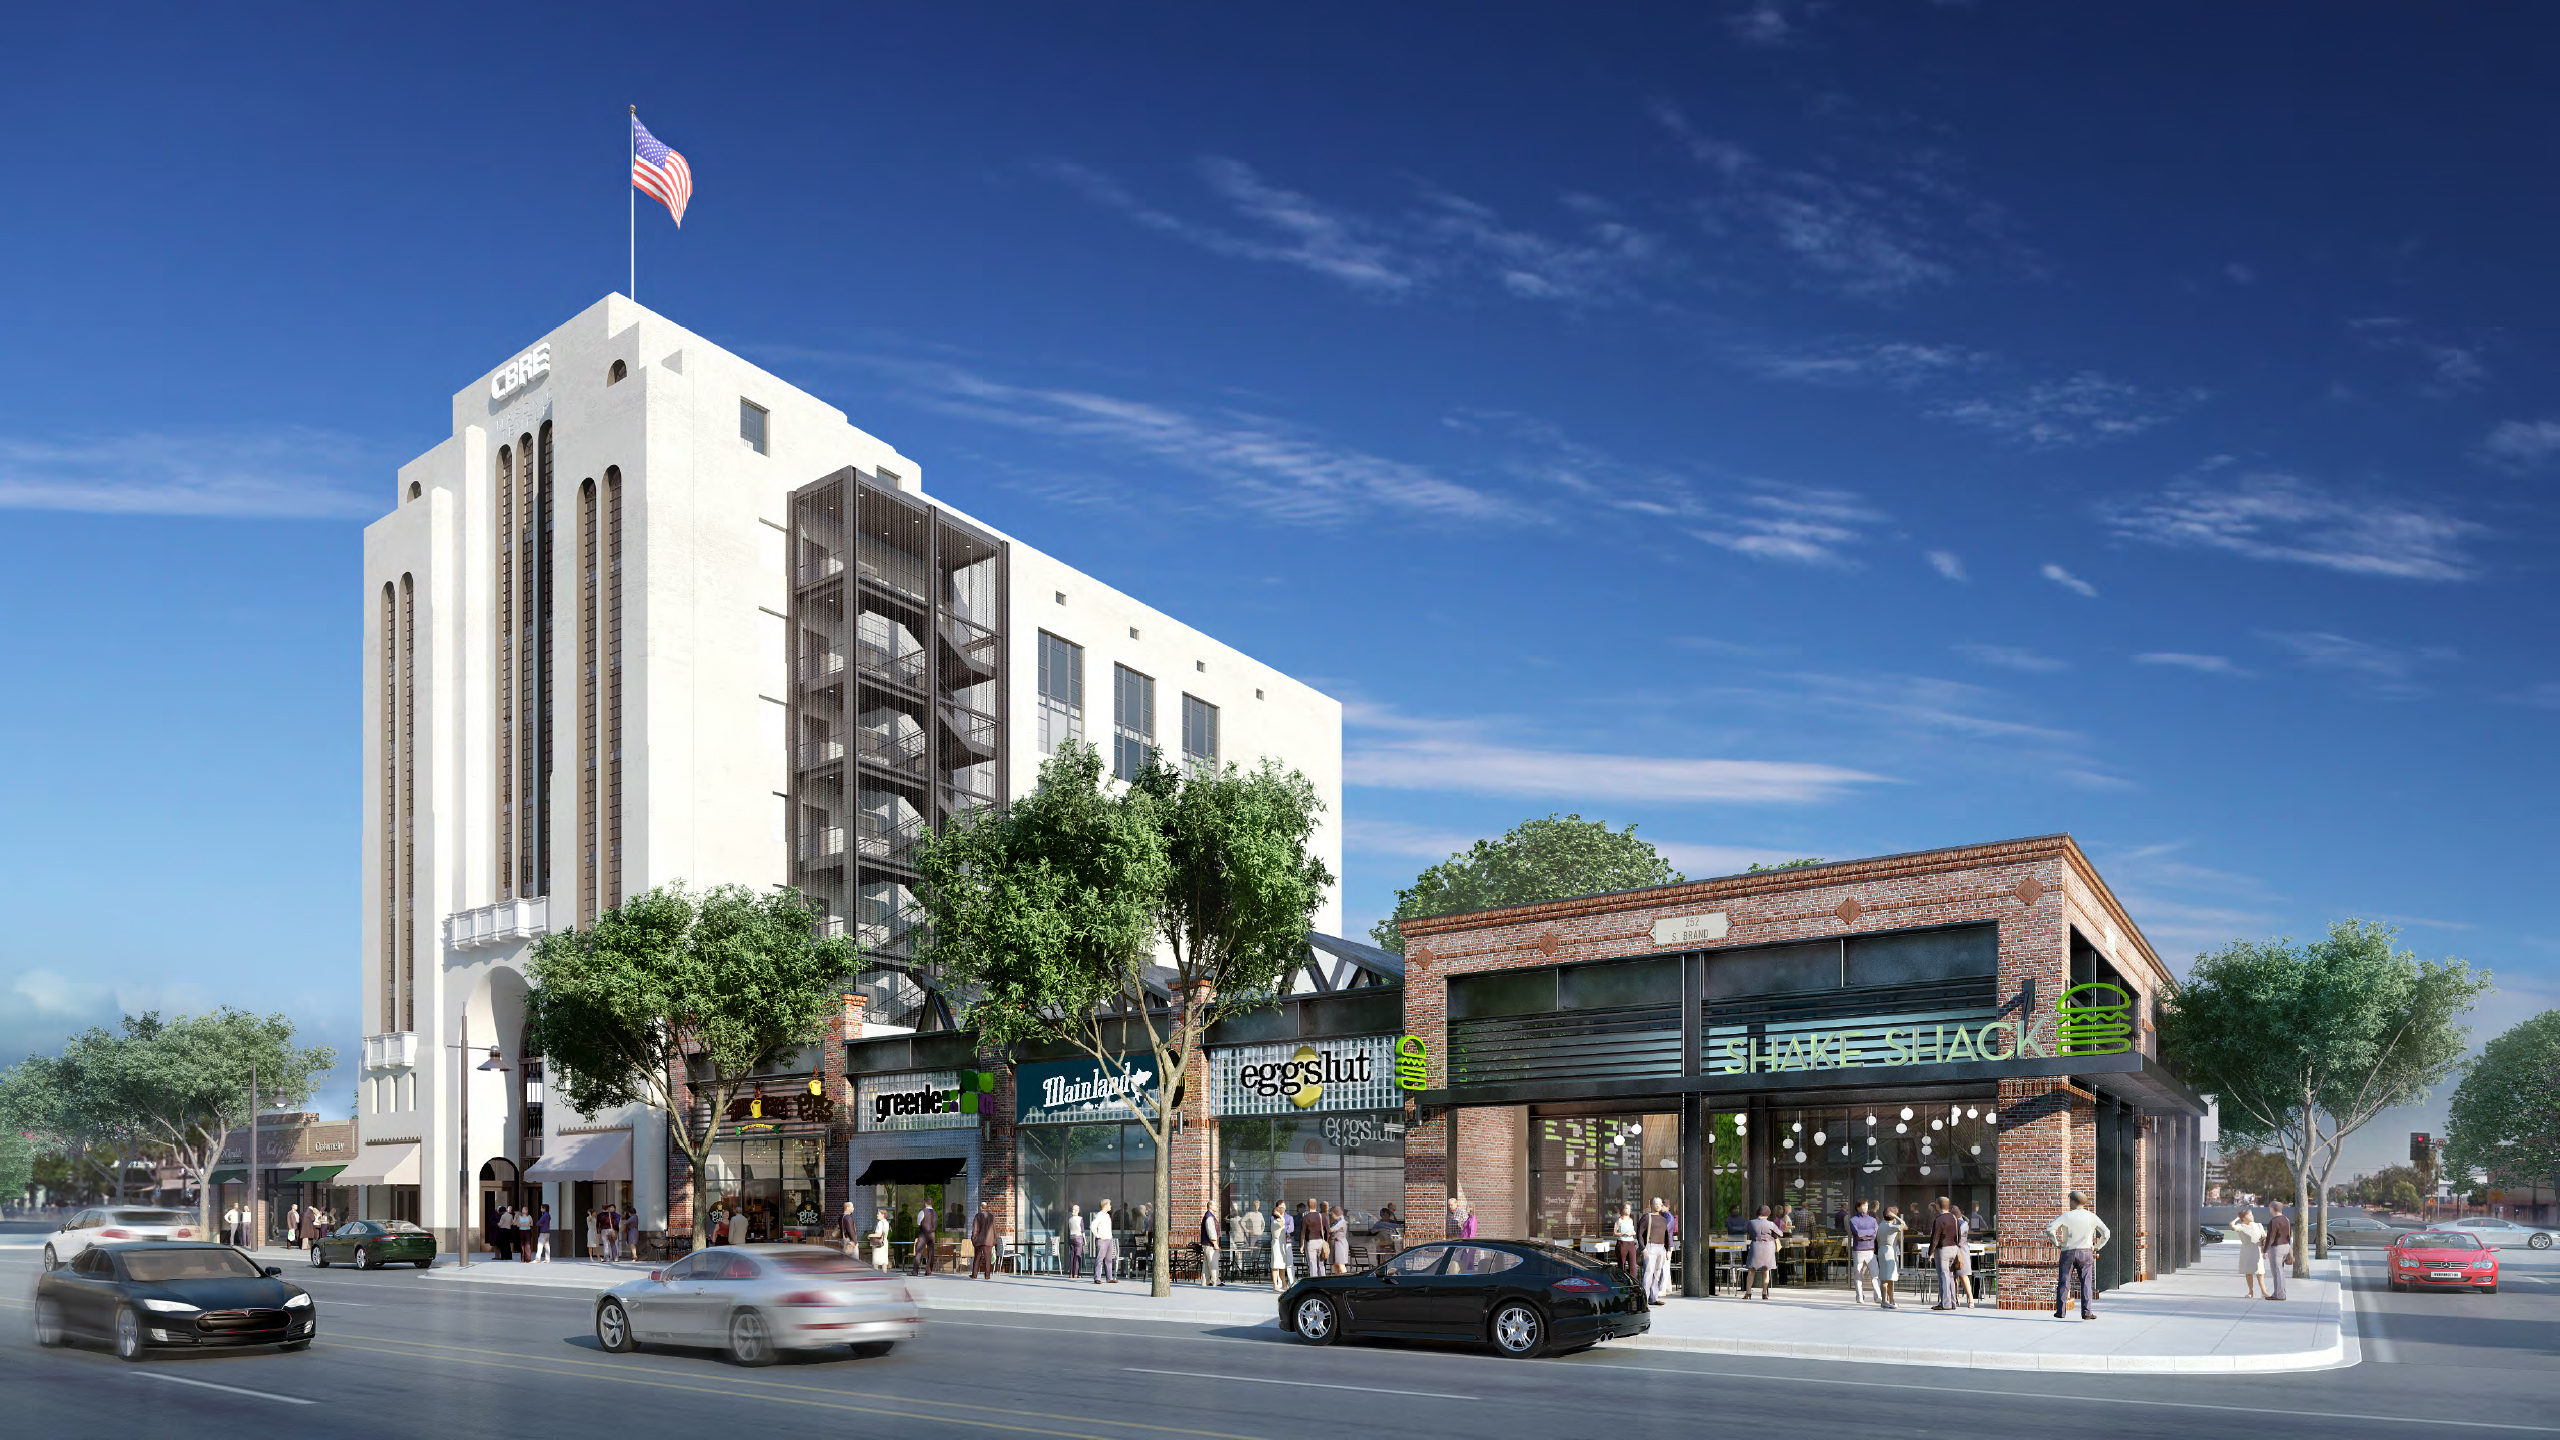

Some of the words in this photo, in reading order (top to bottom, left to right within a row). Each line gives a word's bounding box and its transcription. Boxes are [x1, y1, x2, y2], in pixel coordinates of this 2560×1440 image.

[491, 342, 551, 400] CBRE
[1672, 933, 1679, 941] S.
[1683, 929, 1708, 940] BRAND
[1685, 917, 1700, 927] 252
[1724, 1031, 1864, 1074] SHAKE
[1884, 1019, 2049, 1066] SHACK
[1042, 1061, 1131, 1107] Mainland
[1240, 1048, 1371, 1096] eggslut
